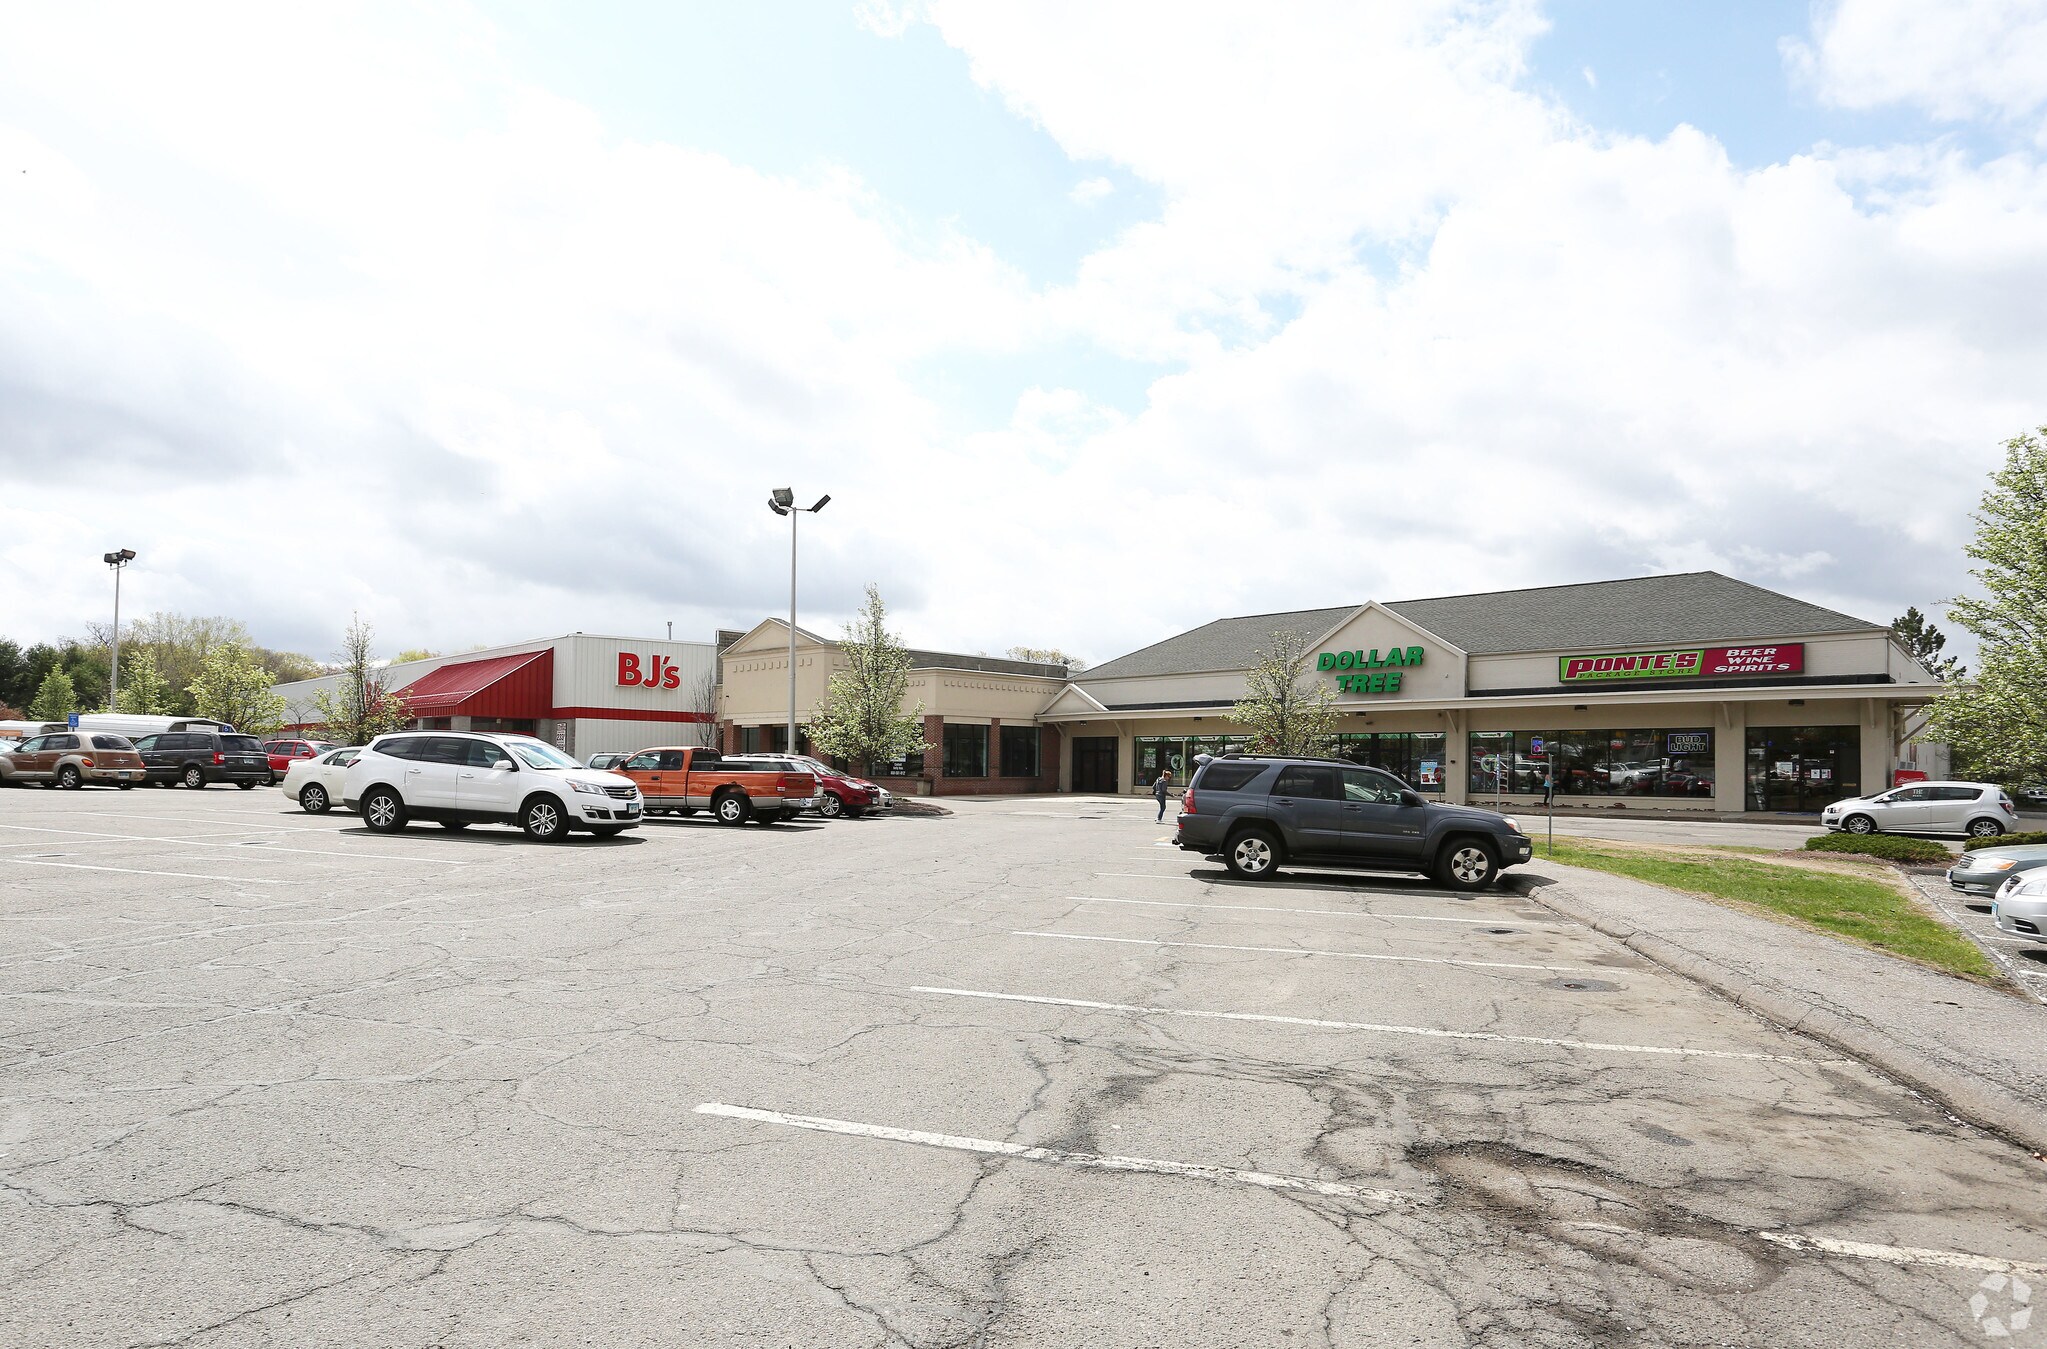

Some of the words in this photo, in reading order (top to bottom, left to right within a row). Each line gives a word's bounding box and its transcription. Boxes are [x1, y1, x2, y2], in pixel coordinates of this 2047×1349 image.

[1726, 648, 1776, 657] BEER
[1317, 646, 1424, 671] DOLLAR
[1727, 656, 1775, 664] WINE
[617, 652, 680, 689] BJ's
[1566, 652, 1699, 679] PONTE'S
[1714, 663, 1790, 673] SPIRITS
[1578, 670, 1639, 679] PACKAGE
[1650, 668, 1694, 676] STORE
[1335, 672, 1403, 693] TREE
[1675, 736, 1701, 744] BUD
[1670, 743, 1706, 752] LIGHT
